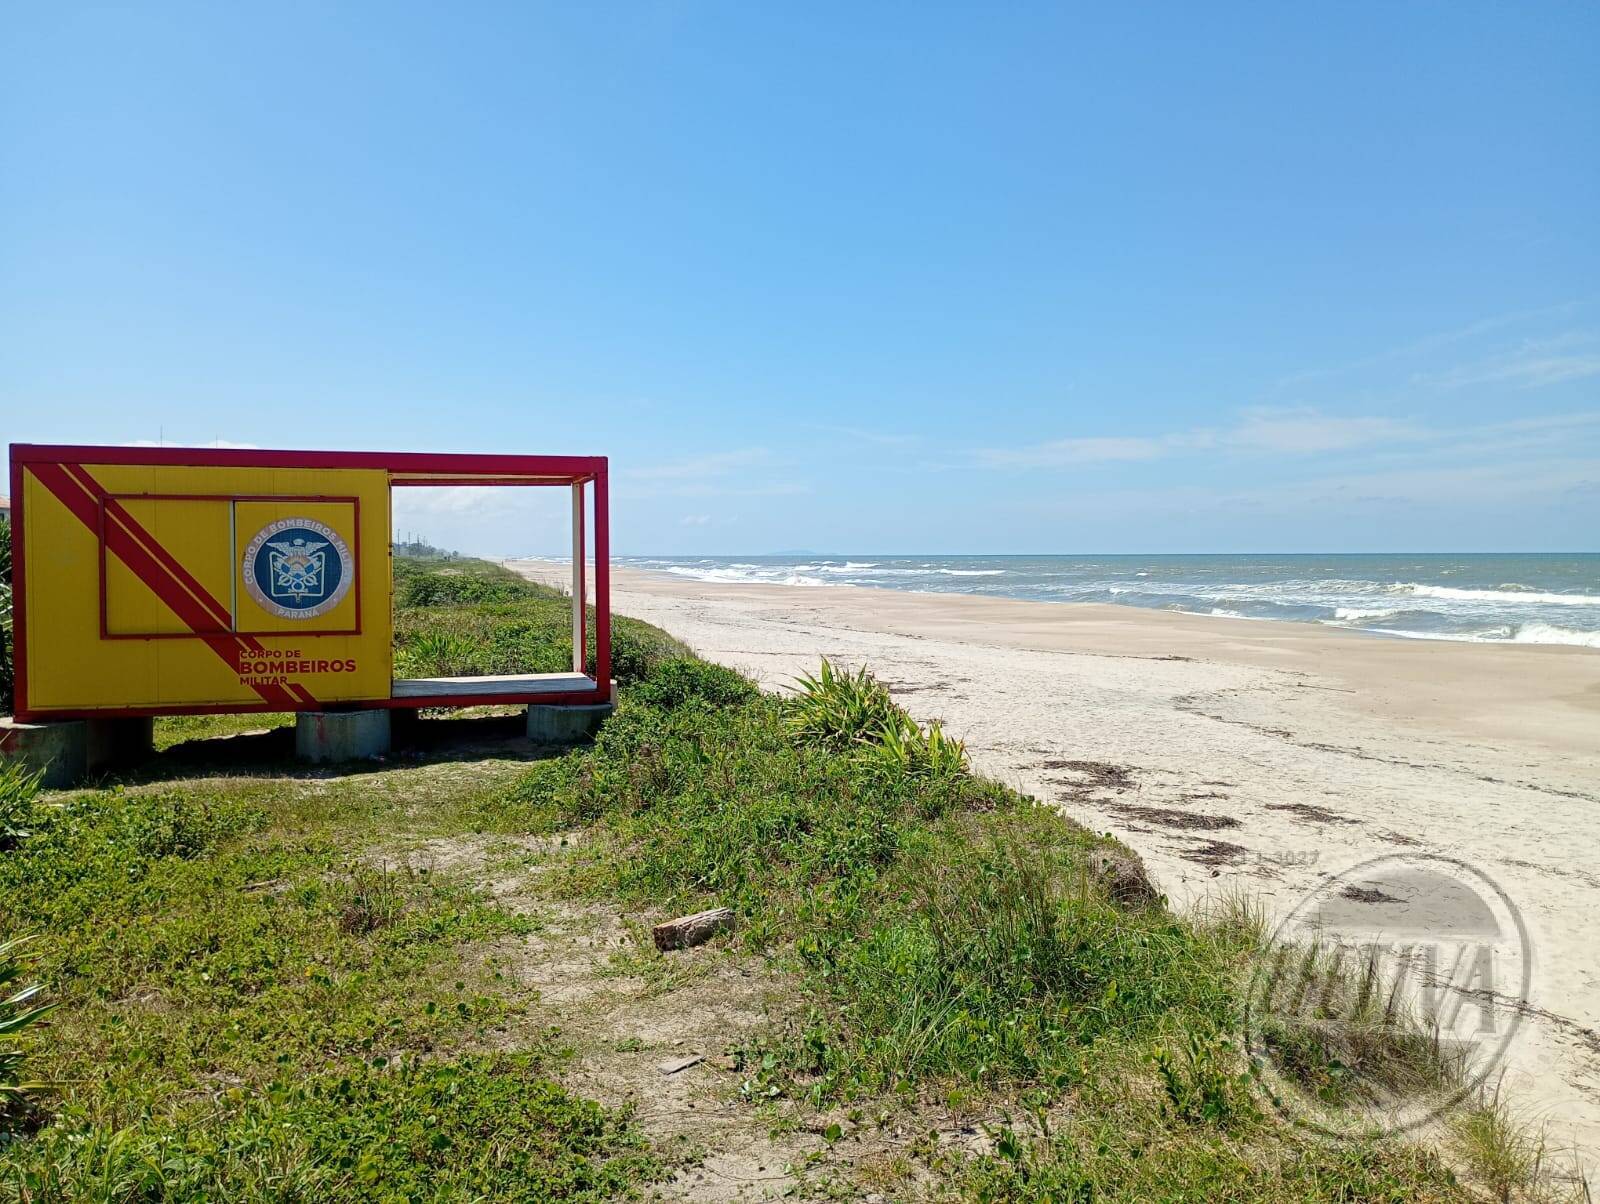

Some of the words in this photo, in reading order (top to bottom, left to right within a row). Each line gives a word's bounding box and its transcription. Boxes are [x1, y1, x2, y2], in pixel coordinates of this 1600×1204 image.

[243, 546, 256, 584] CORPO
[254, 533, 269, 544] DE
[269, 519, 337, 540] BOMBEIROS
[240, 650, 282, 659] CORPO
[285, 650, 301, 658] DE
[240, 660, 356, 674] BOMBEIROS
[240, 676, 287, 685] MILITAR
